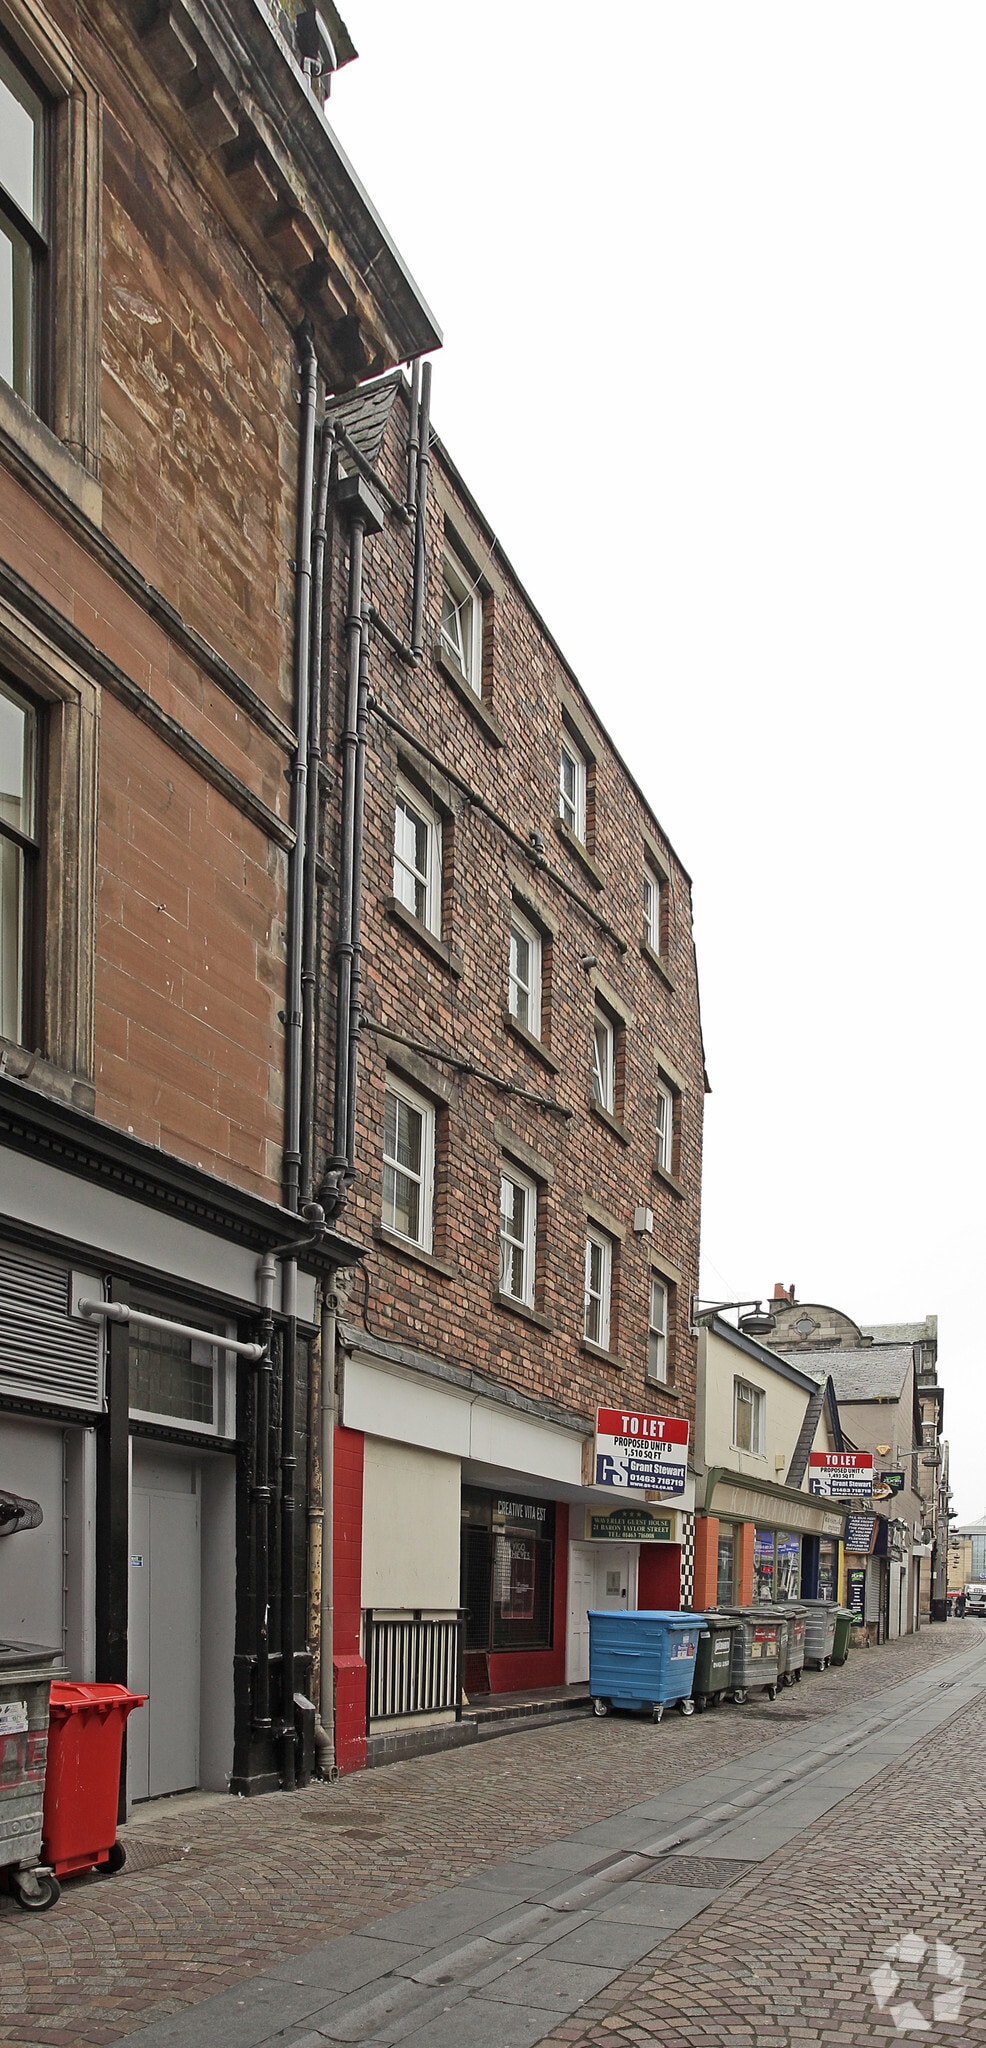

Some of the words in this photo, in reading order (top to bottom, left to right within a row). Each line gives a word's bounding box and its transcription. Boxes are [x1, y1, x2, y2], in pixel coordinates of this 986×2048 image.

[622, 1416, 639, 1434] TO
[642, 1418, 665, 1438] LET
[614, 1437, 649, 1450] PROPOSED
[650, 1442, 666, 1452] UNIT
[667, 1444, 672, 1452] B
[624, 1448, 642, 1458] 1,510
[644, 1451, 652, 1459] SQ
[654, 1452, 662, 1460] FT
[826, 1455, 838, 1465] TO
[841, 1456, 856, 1466] LET
[630, 1460, 652, 1473] Grant
[654, 1464, 684, 1477] Stewart
[630, 1474, 655, 1483] 01463
[497, 1500, 524, 1518] CREATIVE
[524, 1504, 535, 1520] VITA
[536, 1507, 546, 1521] EST
